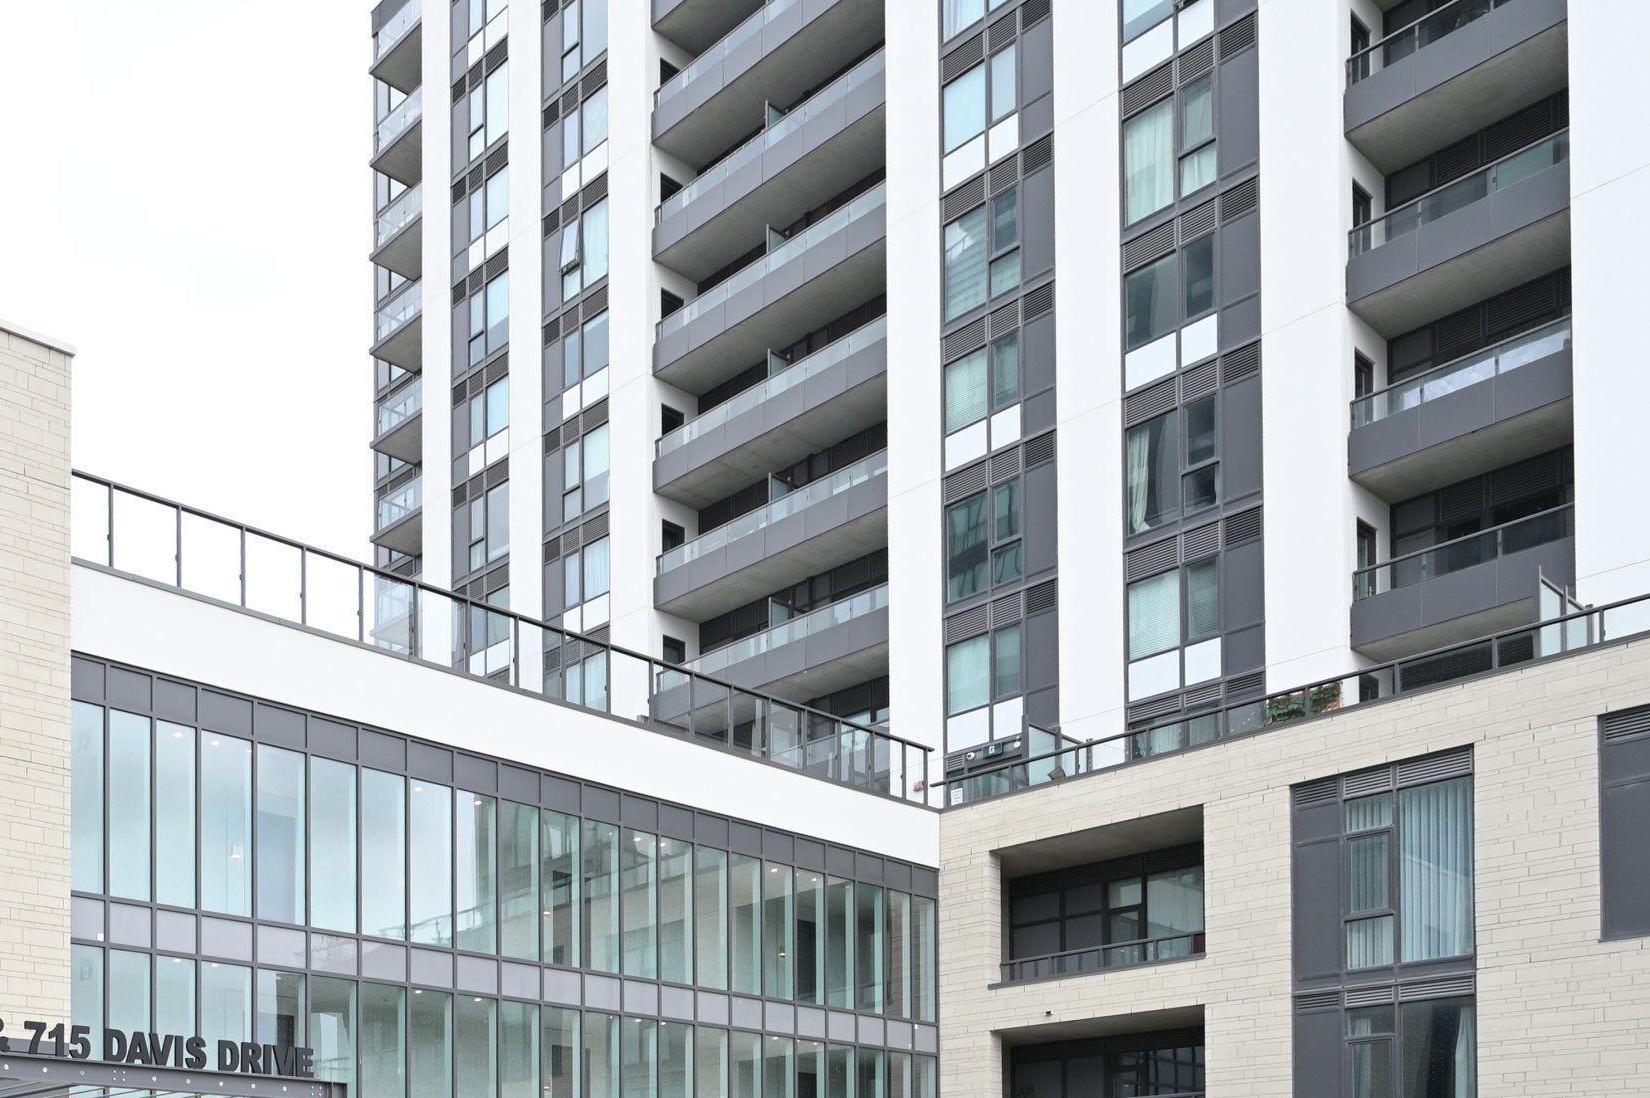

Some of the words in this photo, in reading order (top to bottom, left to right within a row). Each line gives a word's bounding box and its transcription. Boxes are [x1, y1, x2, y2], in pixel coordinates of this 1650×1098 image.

[24, 1020, 91, 1060] 715
[103, 1028, 207, 1069] DAVIS
[217, 1039, 314, 1078] DRIVE
